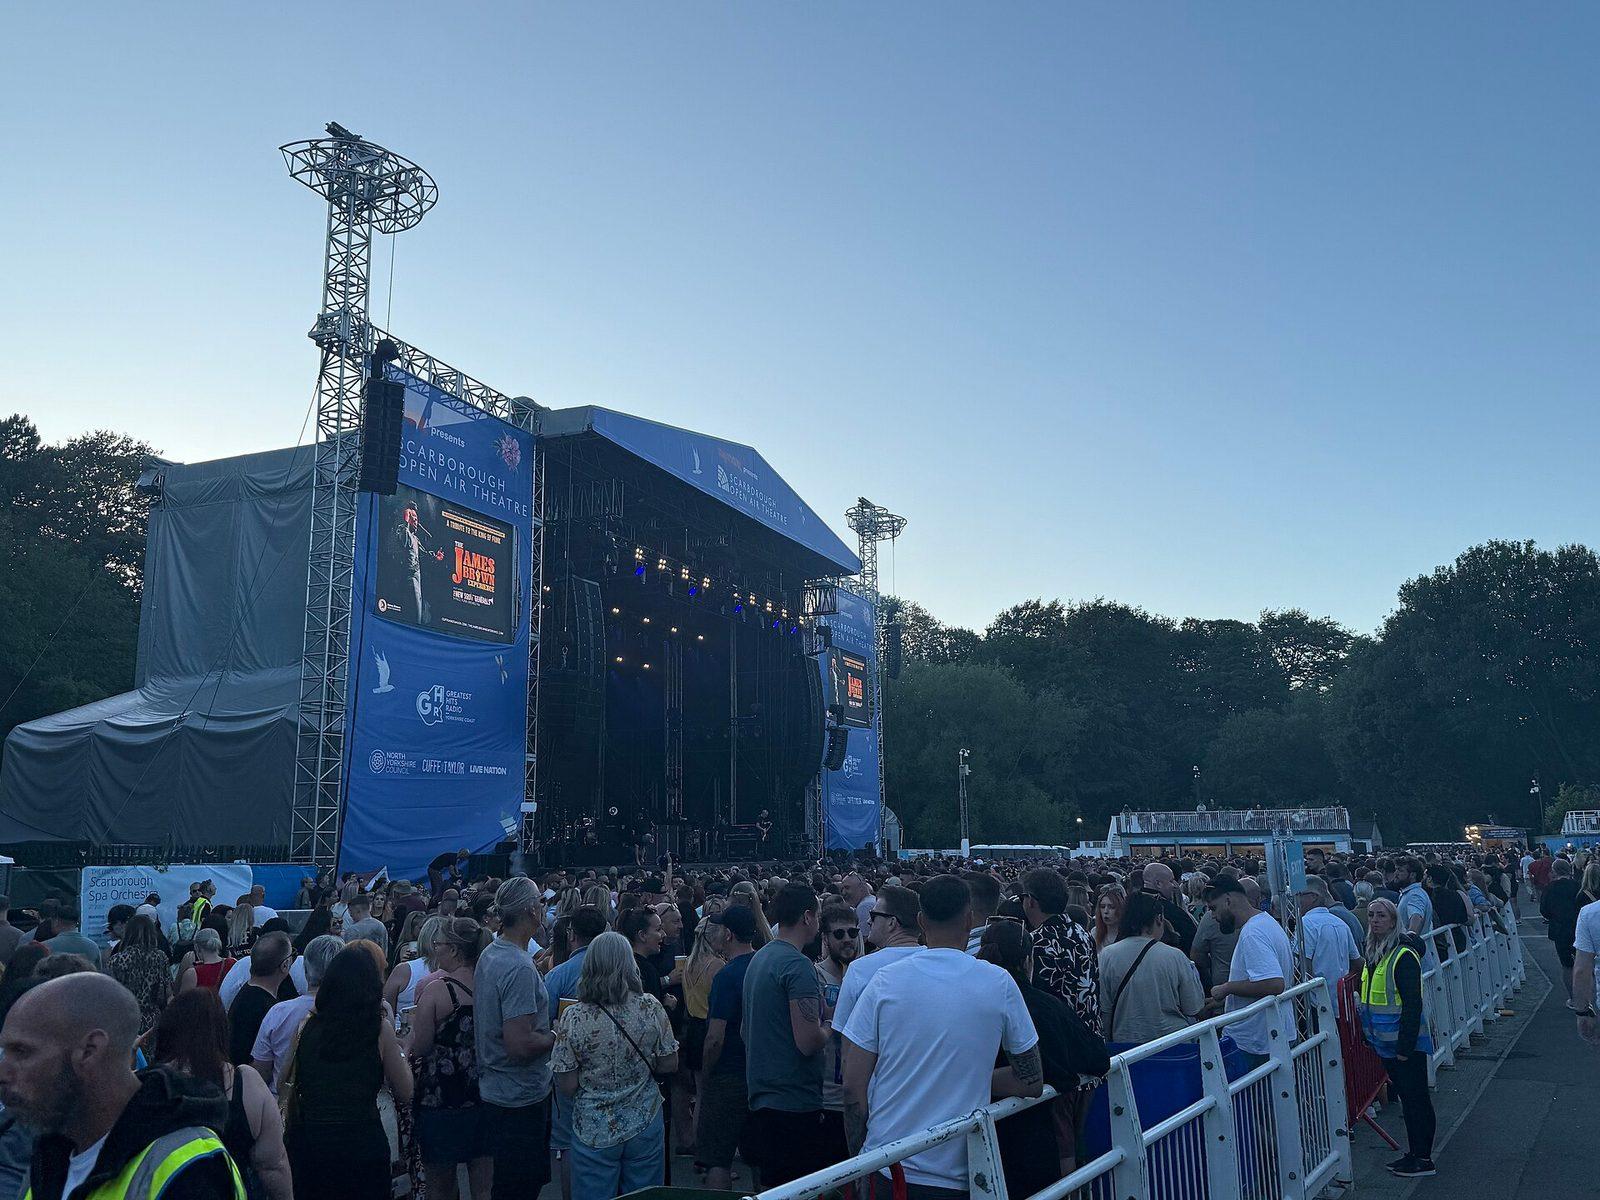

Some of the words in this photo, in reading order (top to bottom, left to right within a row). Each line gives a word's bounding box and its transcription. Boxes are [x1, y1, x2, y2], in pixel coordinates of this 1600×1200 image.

[431, 427, 466, 448] presents
[399, 454, 437, 481] OPEN
[443, 474, 467, 494] AIR
[472, 484, 528, 517] THEATRE
[730, 473, 777, 509] SCARBOROUGH
[729, 485, 748, 502] OPEN
[750, 497, 760, 511] AIR
[761, 503, 788, 526] THEATRE
[452, 547, 496, 584] JAMES
[445, 690, 472, 700] GREATEST
[445, 697, 458, 706] HITS
[445, 704, 463, 714] RADIO
[386, 752, 406, 760] NORTH
[386, 759, 417, 768] YORKSHIRE
[421, 759, 442, 773] CUFFE
[444, 761, 465, 775] TAYLOR
[469, 764, 484, 774] LIVE
[483, 766, 508, 775] NATION
[385, 766, 410, 775] COUNCIL
[89, 876, 154, 889] Scarborough
[88, 890, 108, 903] Spa
